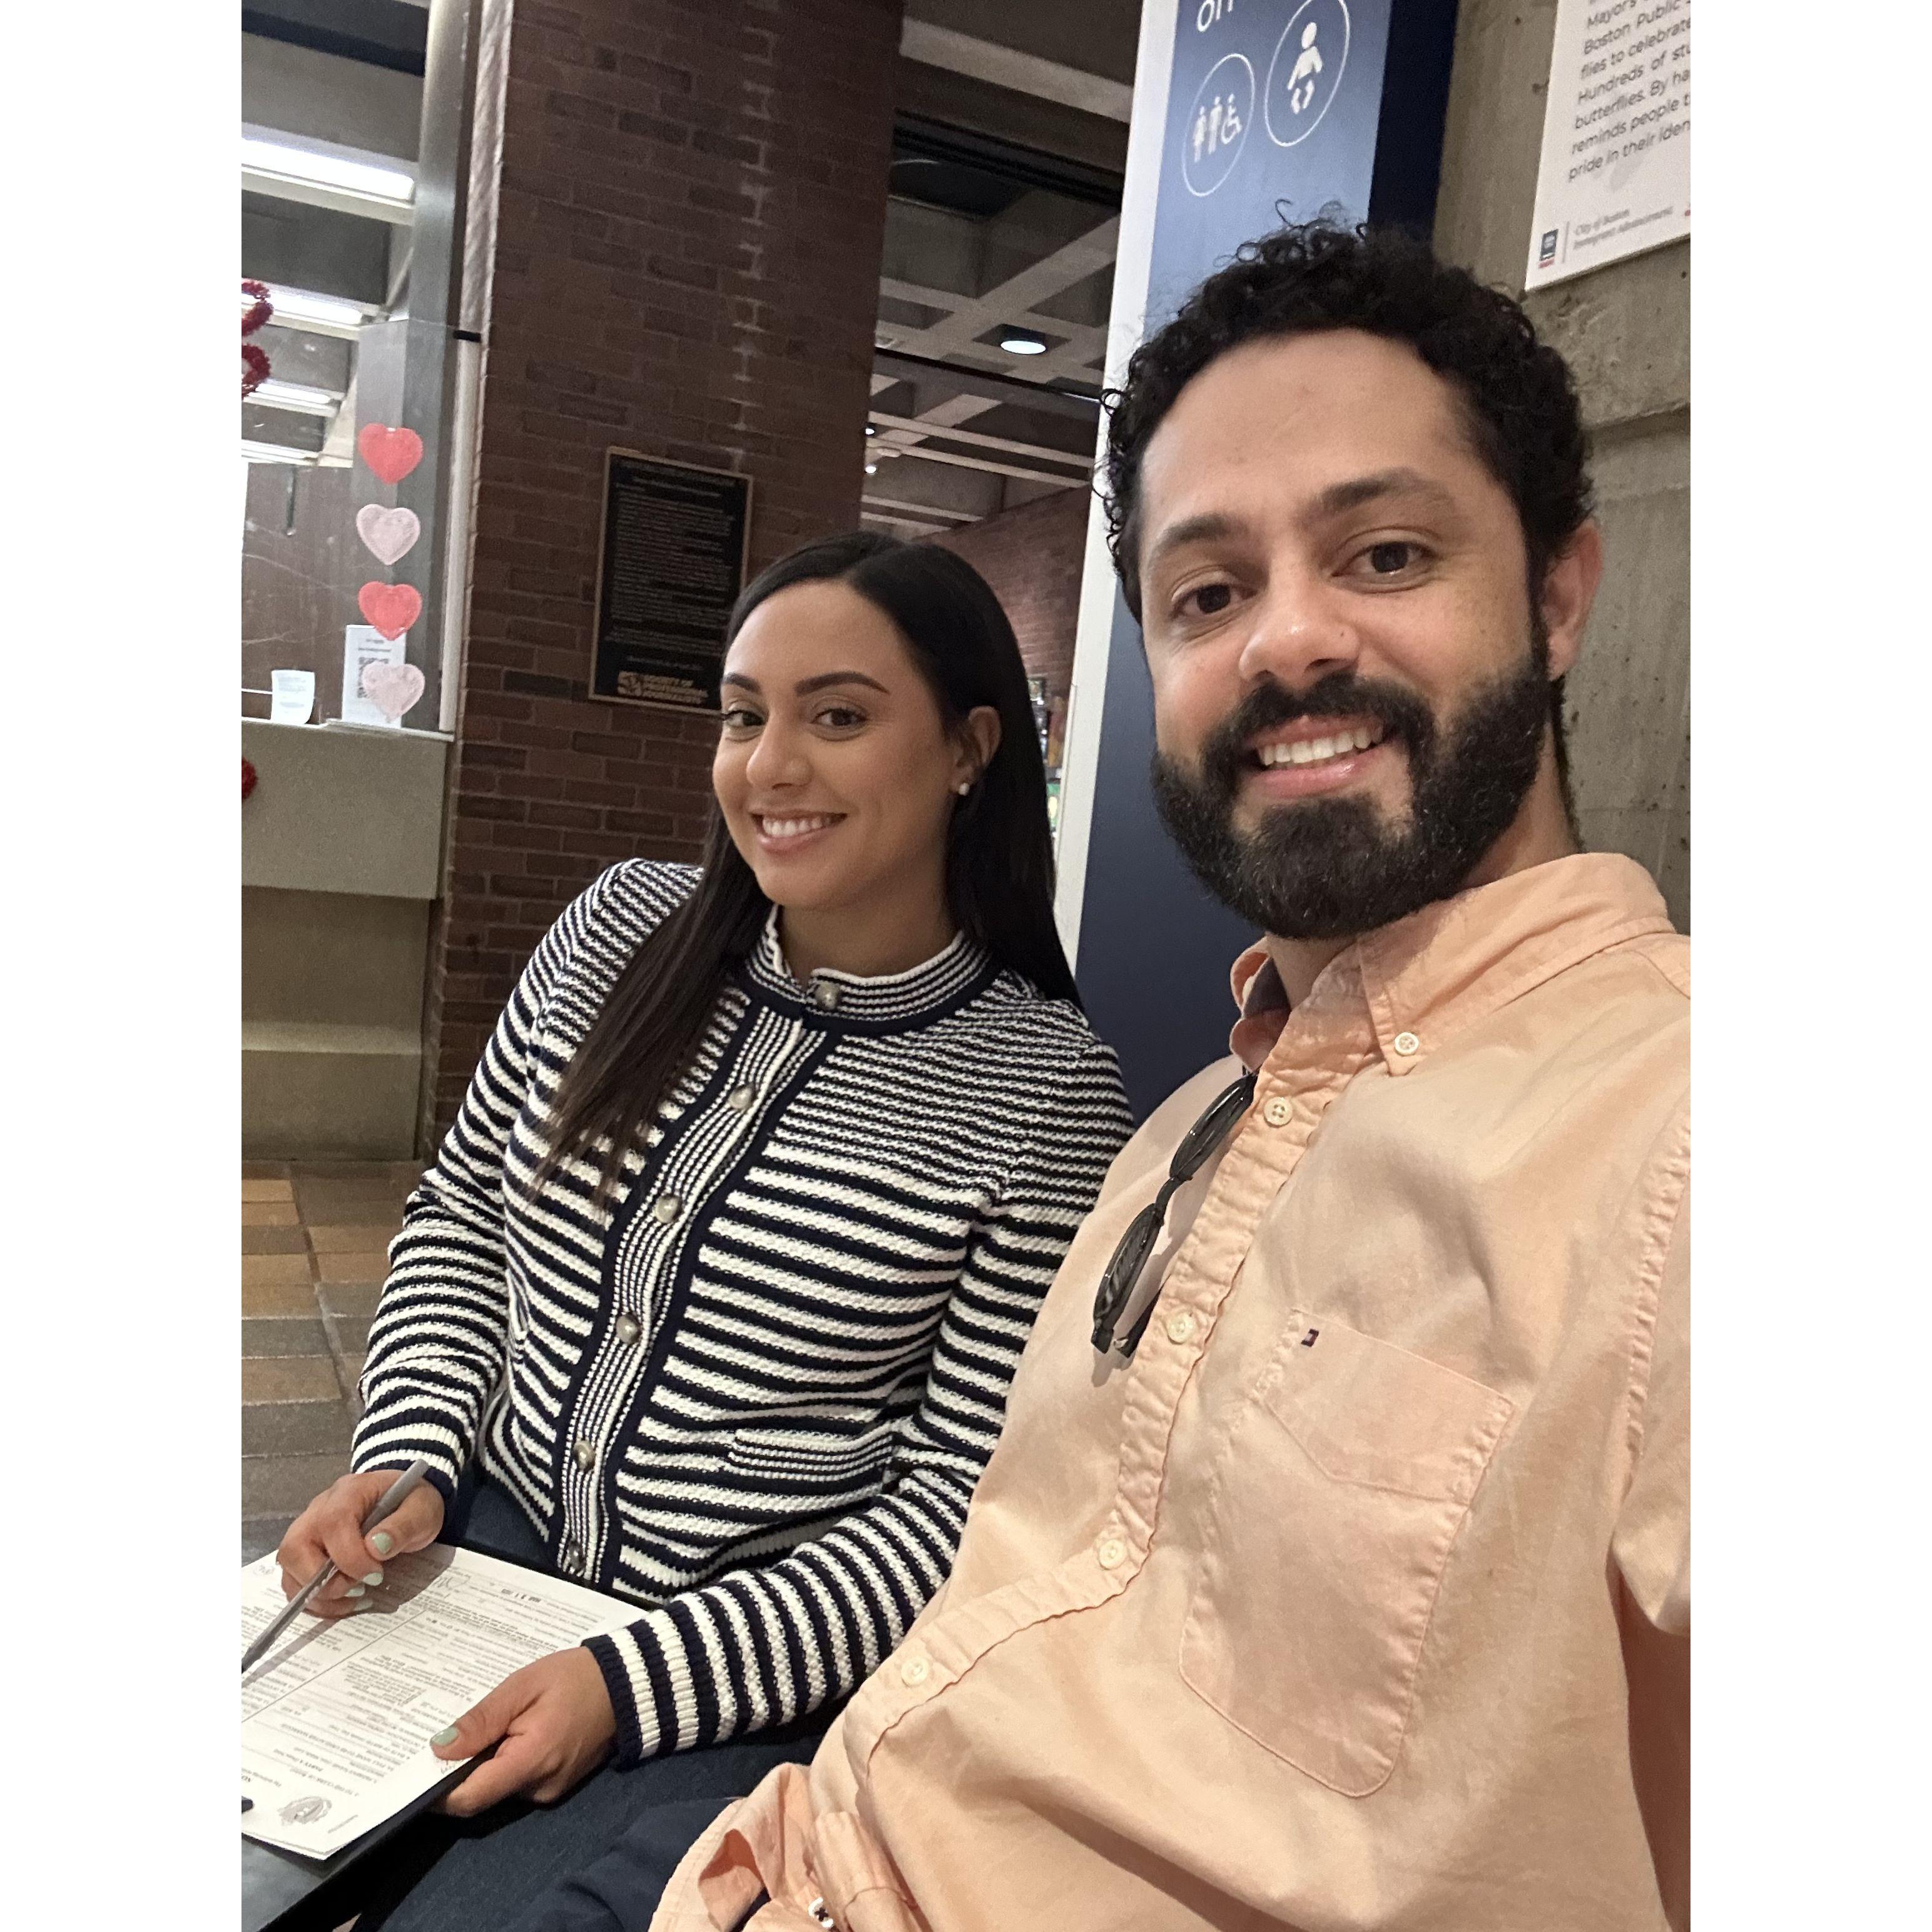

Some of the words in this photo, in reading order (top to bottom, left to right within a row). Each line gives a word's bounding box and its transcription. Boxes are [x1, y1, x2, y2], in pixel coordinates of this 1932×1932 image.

[1587, 0, 1637, 29] Mayors
[1584, 24, 1630, 54] Boston
[1610, 51, 1625, 65] to
[1578, 64, 1644, 104] Hundreds
[1650, 50, 1667, 71] of
[1650, 78, 1669, 96] By
[1572, 123, 1627, 155] reminds
[1630, 99, 1679, 132] people
[1568, 157, 1603, 183] pride
[1623, 132, 1655, 157] their
